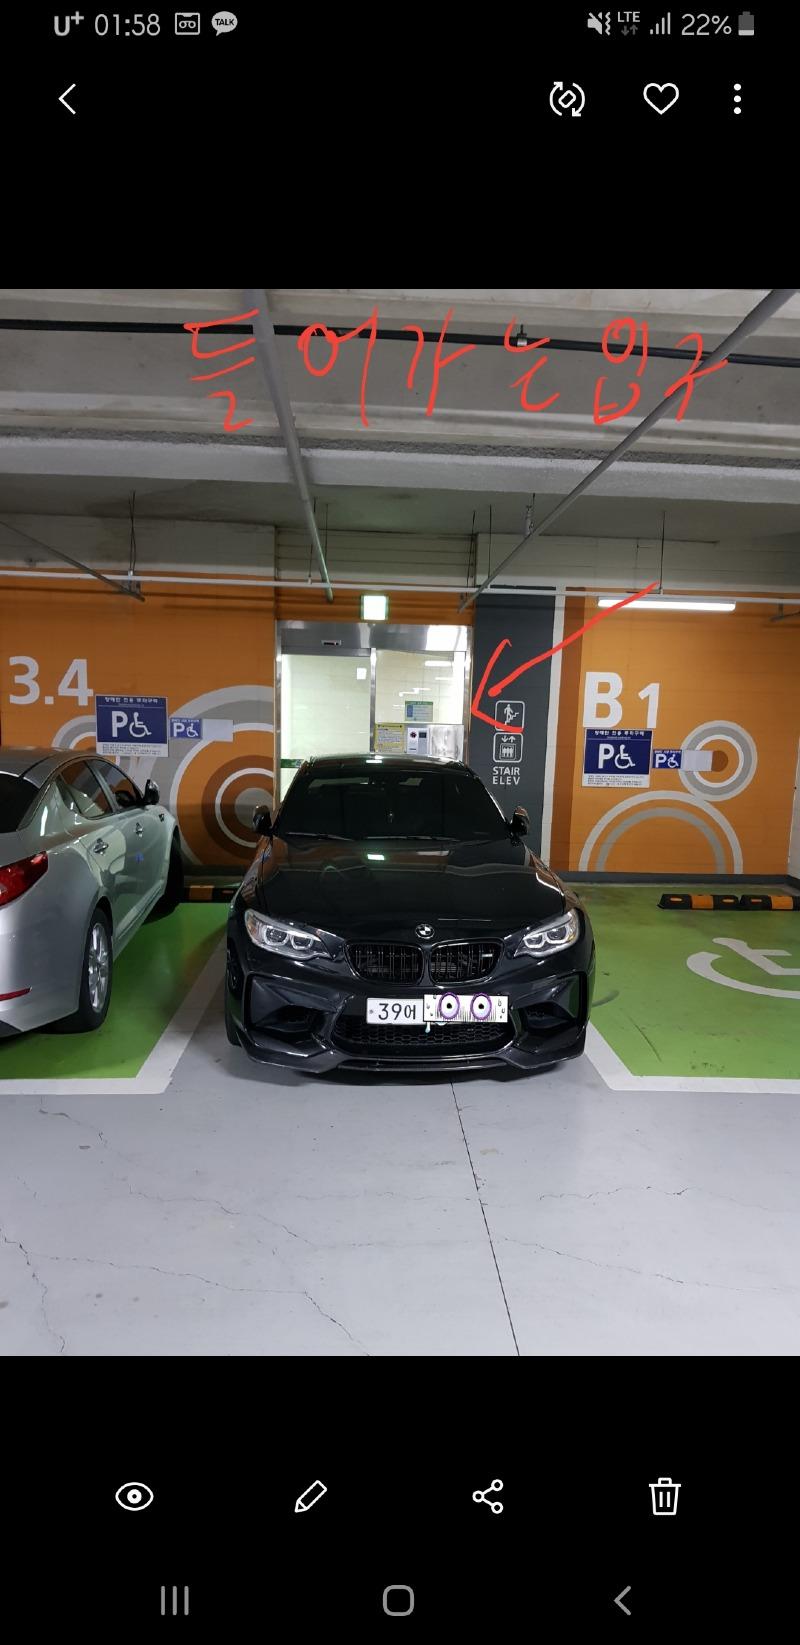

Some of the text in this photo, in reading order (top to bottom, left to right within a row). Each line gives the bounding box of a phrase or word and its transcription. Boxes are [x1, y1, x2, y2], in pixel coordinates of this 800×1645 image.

[9, 655, 94, 706] 3.4
[112, 710, 128, 738] P
[173, 722, 185, 737] P
[598, 743, 615, 769] P
[655, 753, 667, 768] P
[492, 766, 521, 776] STAIR
[492, 775, 521, 785] ELEV
[378, 1003, 416, 1021] 39어
